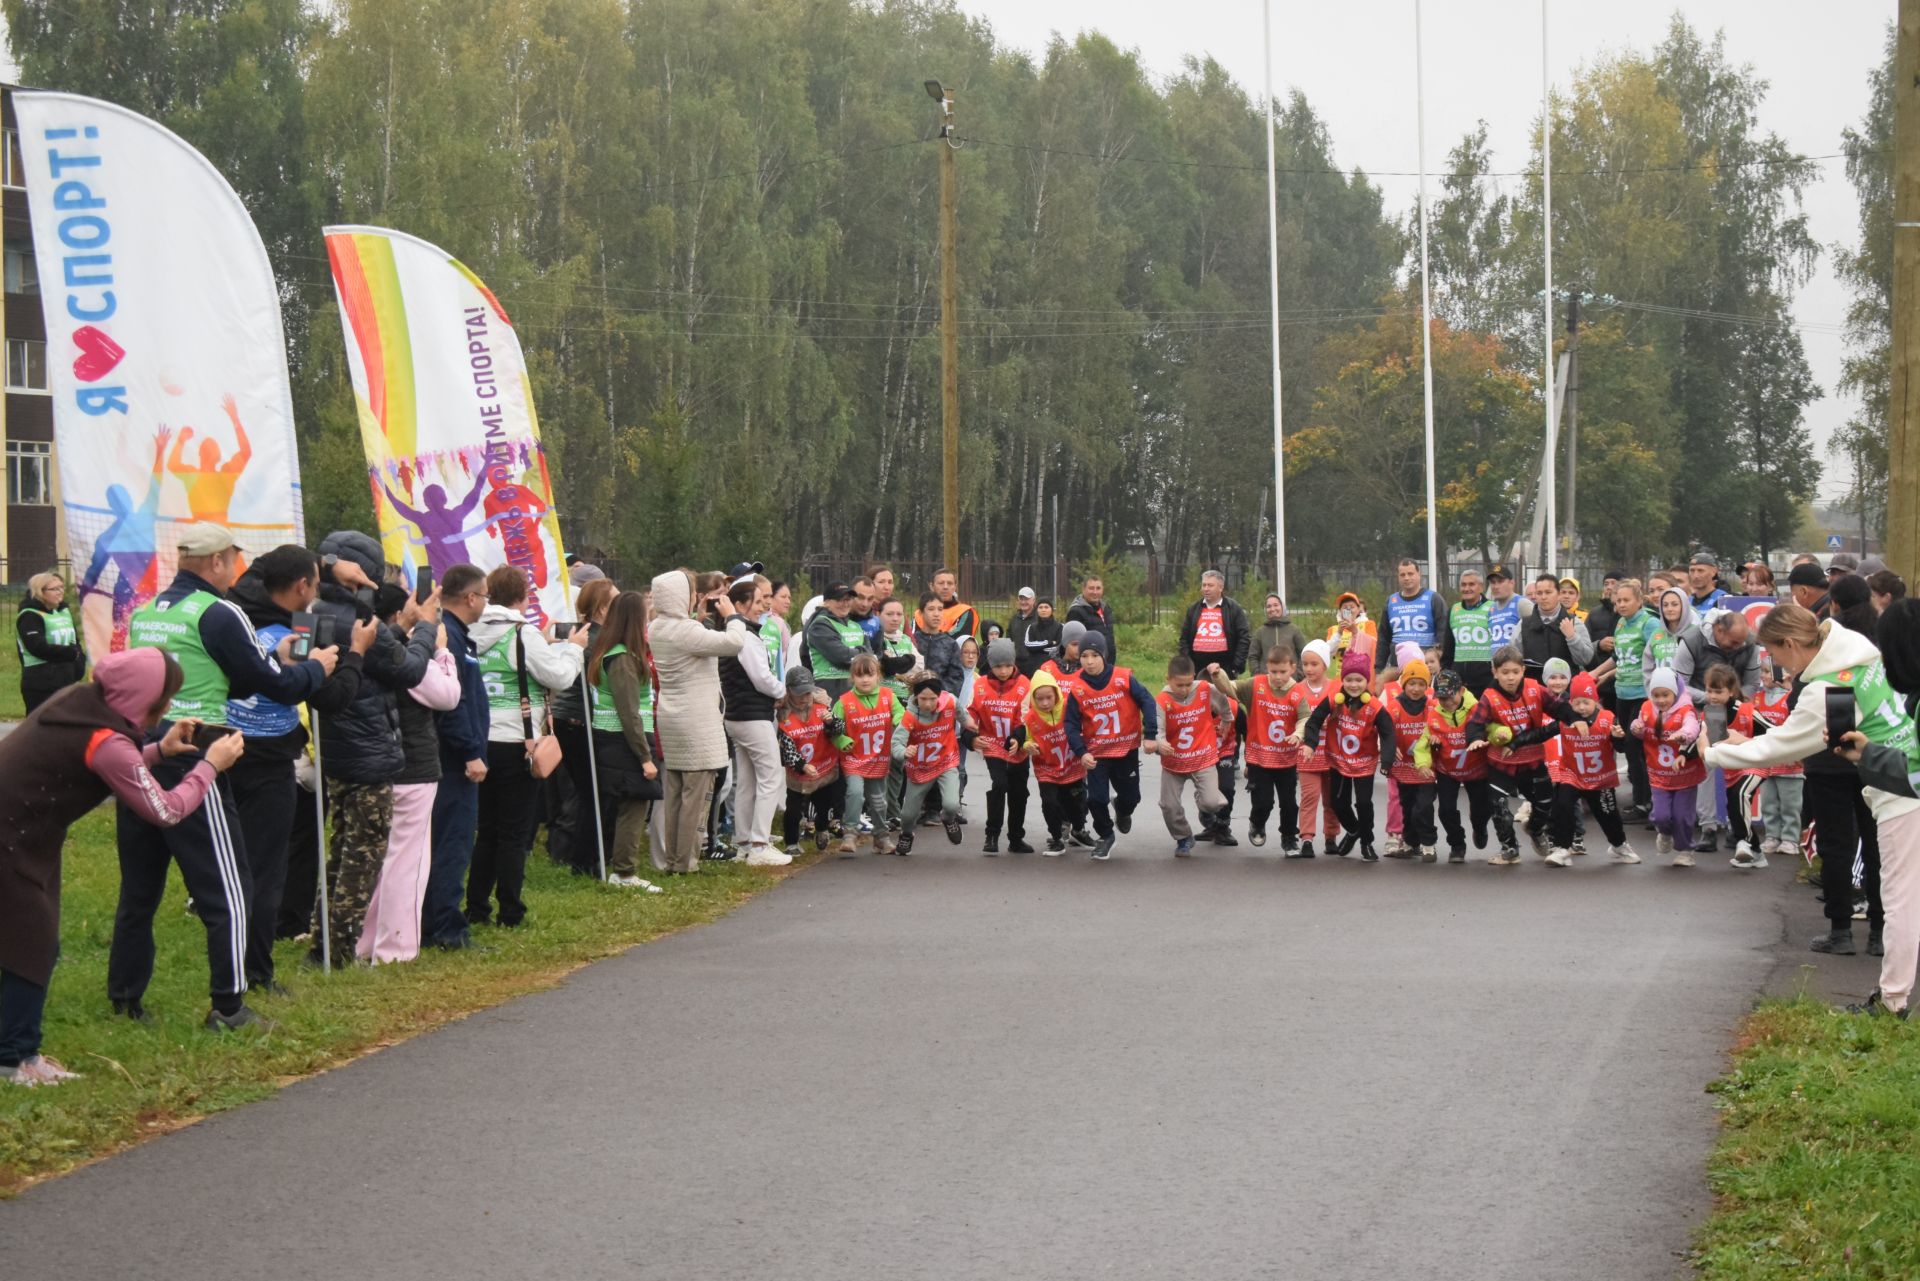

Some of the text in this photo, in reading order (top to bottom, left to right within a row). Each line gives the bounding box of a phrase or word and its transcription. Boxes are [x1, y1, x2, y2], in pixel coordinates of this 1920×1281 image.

[44, 125, 129, 416] Я СПОРТ!
[463, 305, 499, 400] СПОРТА!
[479, 404, 515, 482] РИТМЕ
[498, 487, 520, 501] В
[1389, 615, 1429, 633] 216
[1453, 626, 1489, 644] 160
[1093, 701, 1117, 710] РАЙОН
[853, 711, 890, 724] ТУКАЕВСКИЙ
[991, 716, 1012, 738] 11
[1093, 710, 1122, 735] 21
[860, 730, 885, 756] 18
[1177, 726, 1195, 750] 5
[1268, 719, 1286, 744] 6
[1336, 727, 1361, 755] 10
[801, 743, 815, 764] 9
[917, 742, 944, 762] 12
[1450, 748, 1469, 769] 7
[1573, 751, 1604, 774] 13
[1658, 744, 1675, 767] 8
